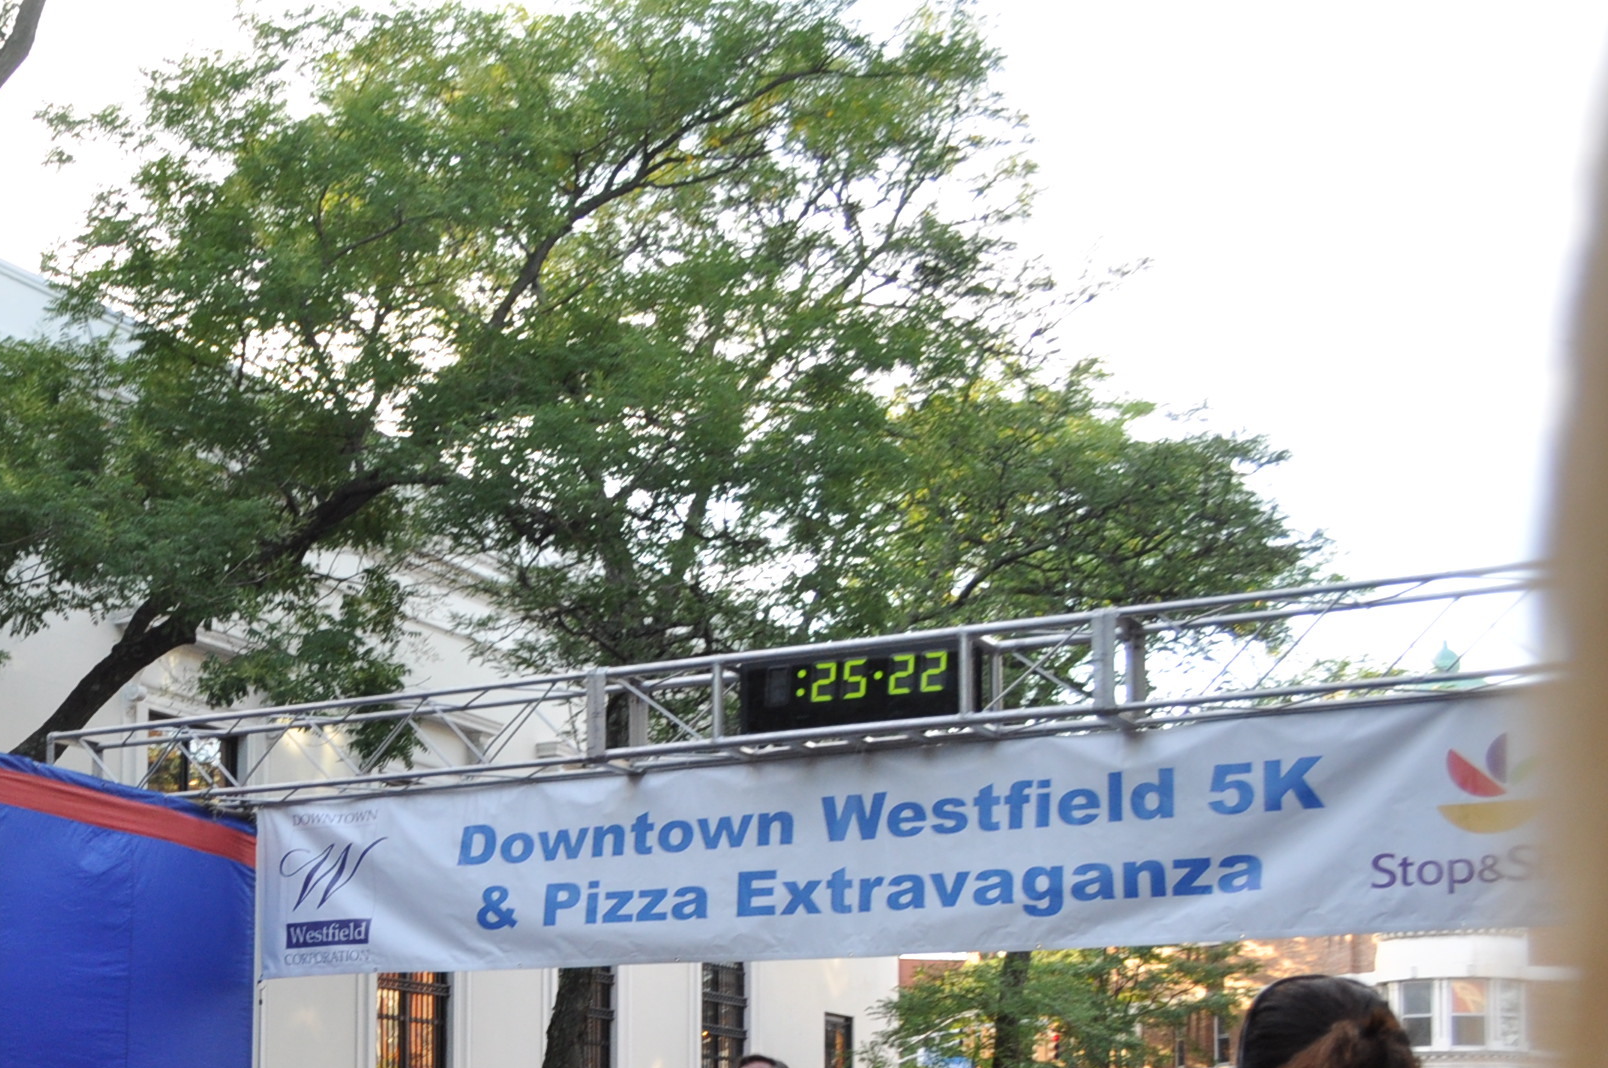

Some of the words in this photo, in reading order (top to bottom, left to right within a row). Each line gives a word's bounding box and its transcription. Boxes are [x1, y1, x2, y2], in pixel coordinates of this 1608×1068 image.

[293, 809, 379, 827] DOWNTOWN
[457, 811, 795, 867] Downtown
[820, 766, 1175, 843] Westfield
[1207, 755, 1326, 816] 5K
[279, 836, 389, 912] W
[476, 885, 518, 931] &
[542, 880, 709, 927] Pizza
[736, 853, 1264, 918] Extravaganza
[1370, 844, 1538, 895] Stop&S
[283, 949, 372, 967] CORPORATION
[289, 920, 368, 945] Westfield
